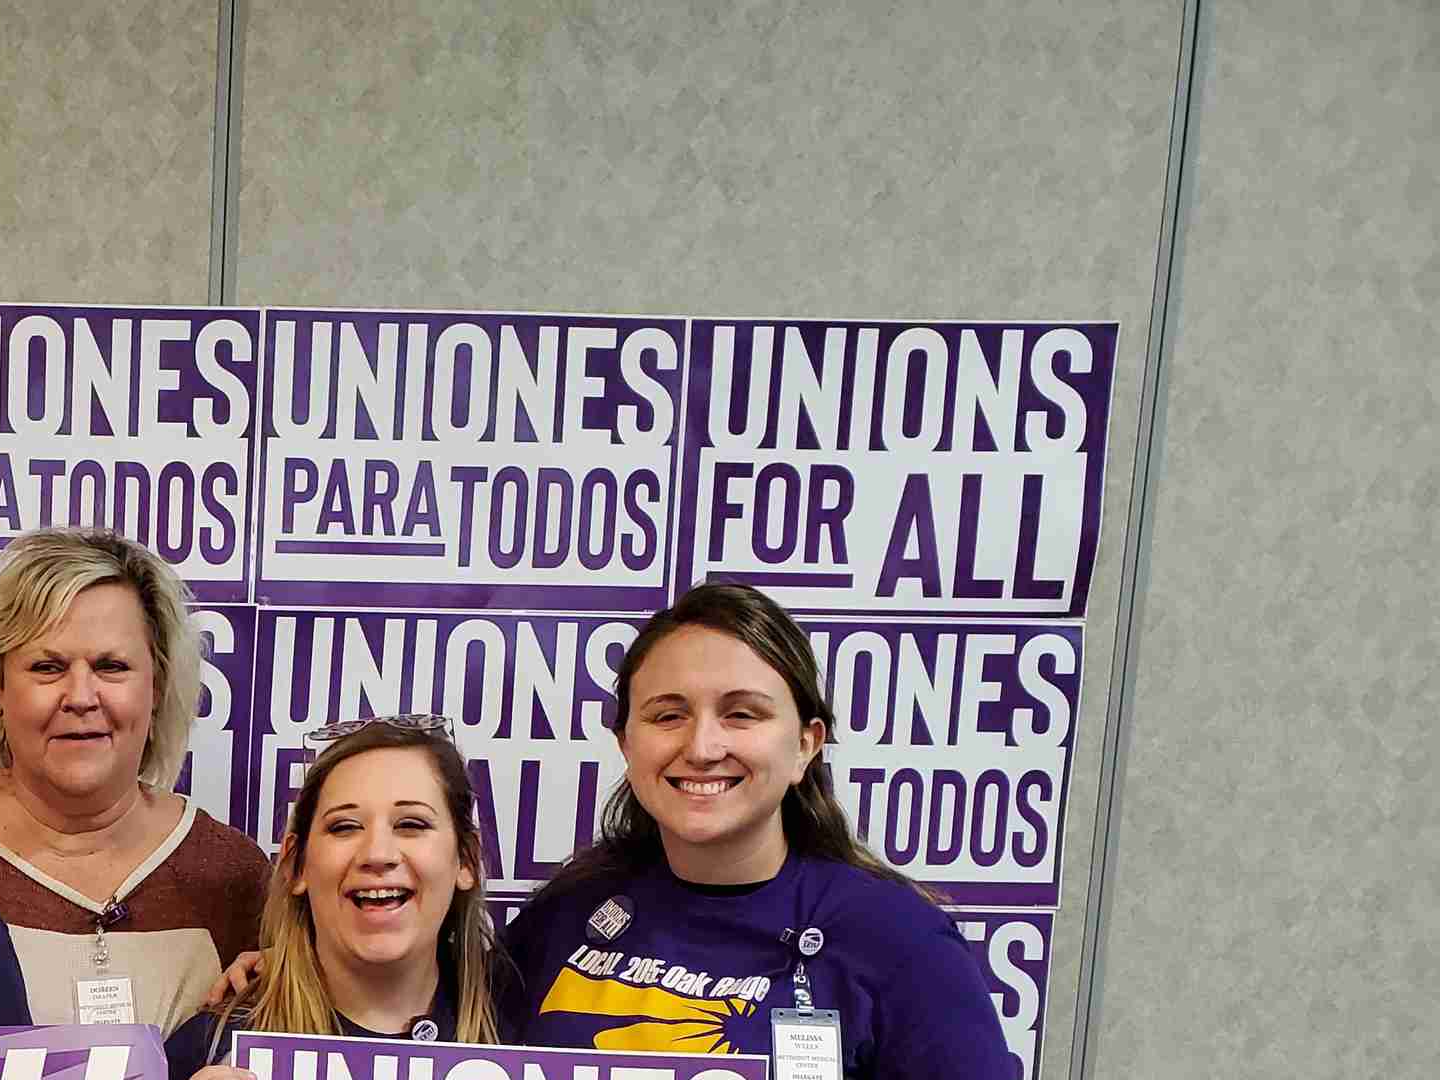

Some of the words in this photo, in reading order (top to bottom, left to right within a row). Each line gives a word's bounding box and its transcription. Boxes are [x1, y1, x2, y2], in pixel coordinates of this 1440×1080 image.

[272, 320, 678, 445] UNIONES
[708, 326, 1093, 453] UNIONS
[28, 459, 238, 565] TODOS
[281, 457, 442, 537] PARA
[449, 465, 661, 571] TODOS
[707, 462, 855, 564] FOR
[875, 473, 1066, 600] ALL
[271, 616, 640, 745] UNIONS
[849, 767, 1053, 868] TODOS
